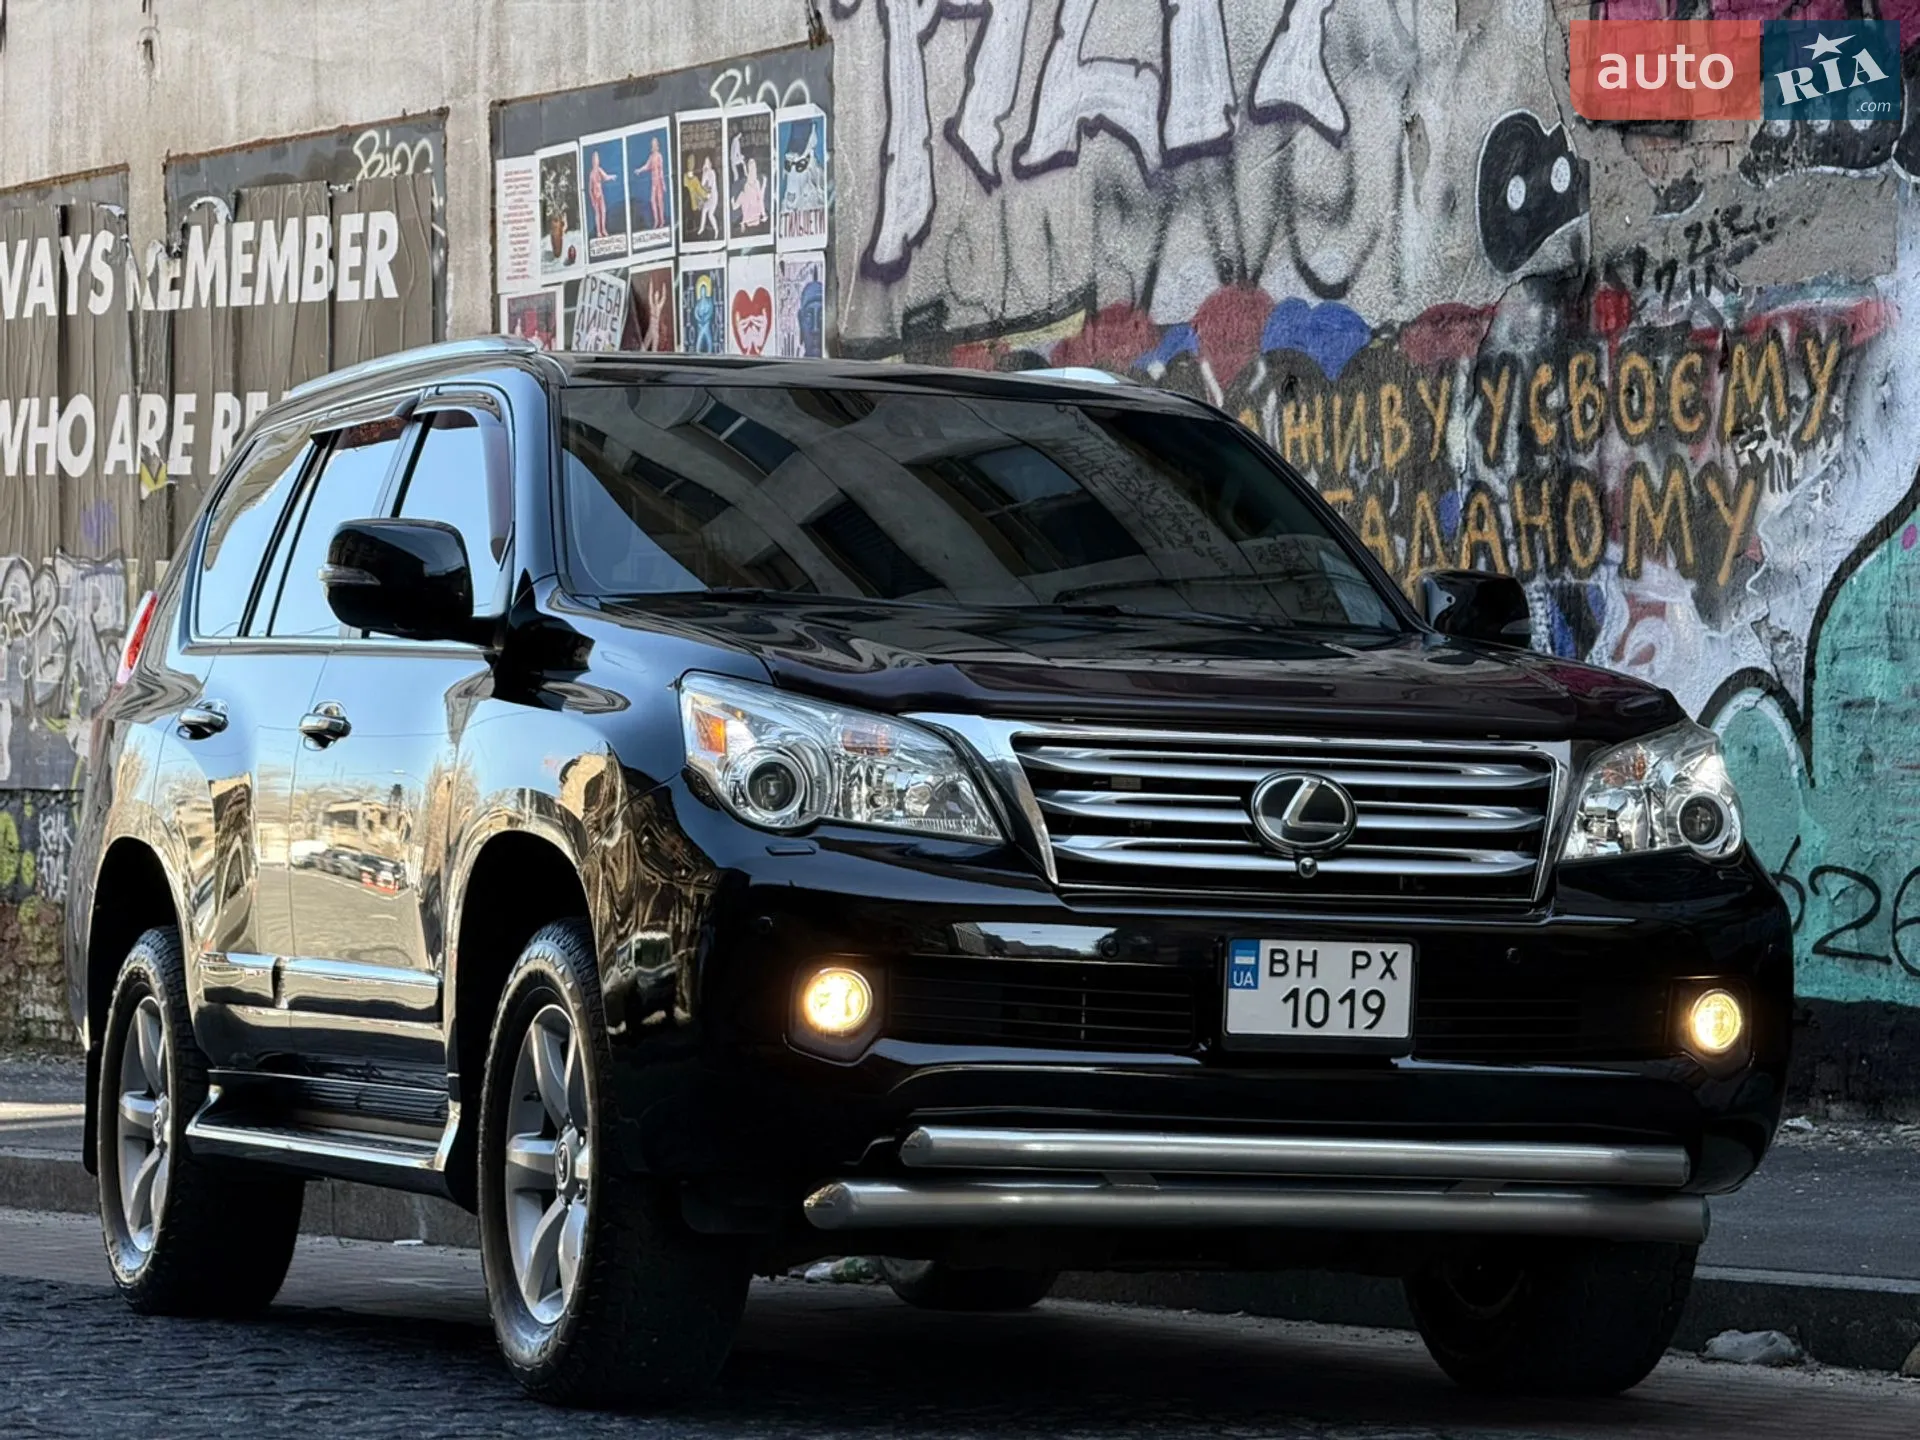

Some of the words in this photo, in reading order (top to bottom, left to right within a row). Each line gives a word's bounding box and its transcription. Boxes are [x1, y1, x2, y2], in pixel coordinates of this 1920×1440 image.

[103, 393, 197, 475] ARE
[1282, 376, 1450, 474] ЖИВУ
[1232, 971, 1255, 987] UA
[1268, 948, 1318, 978] BH
[1351, 950, 1399, 980] PX
[1281, 987, 1386, 1030] 1019
